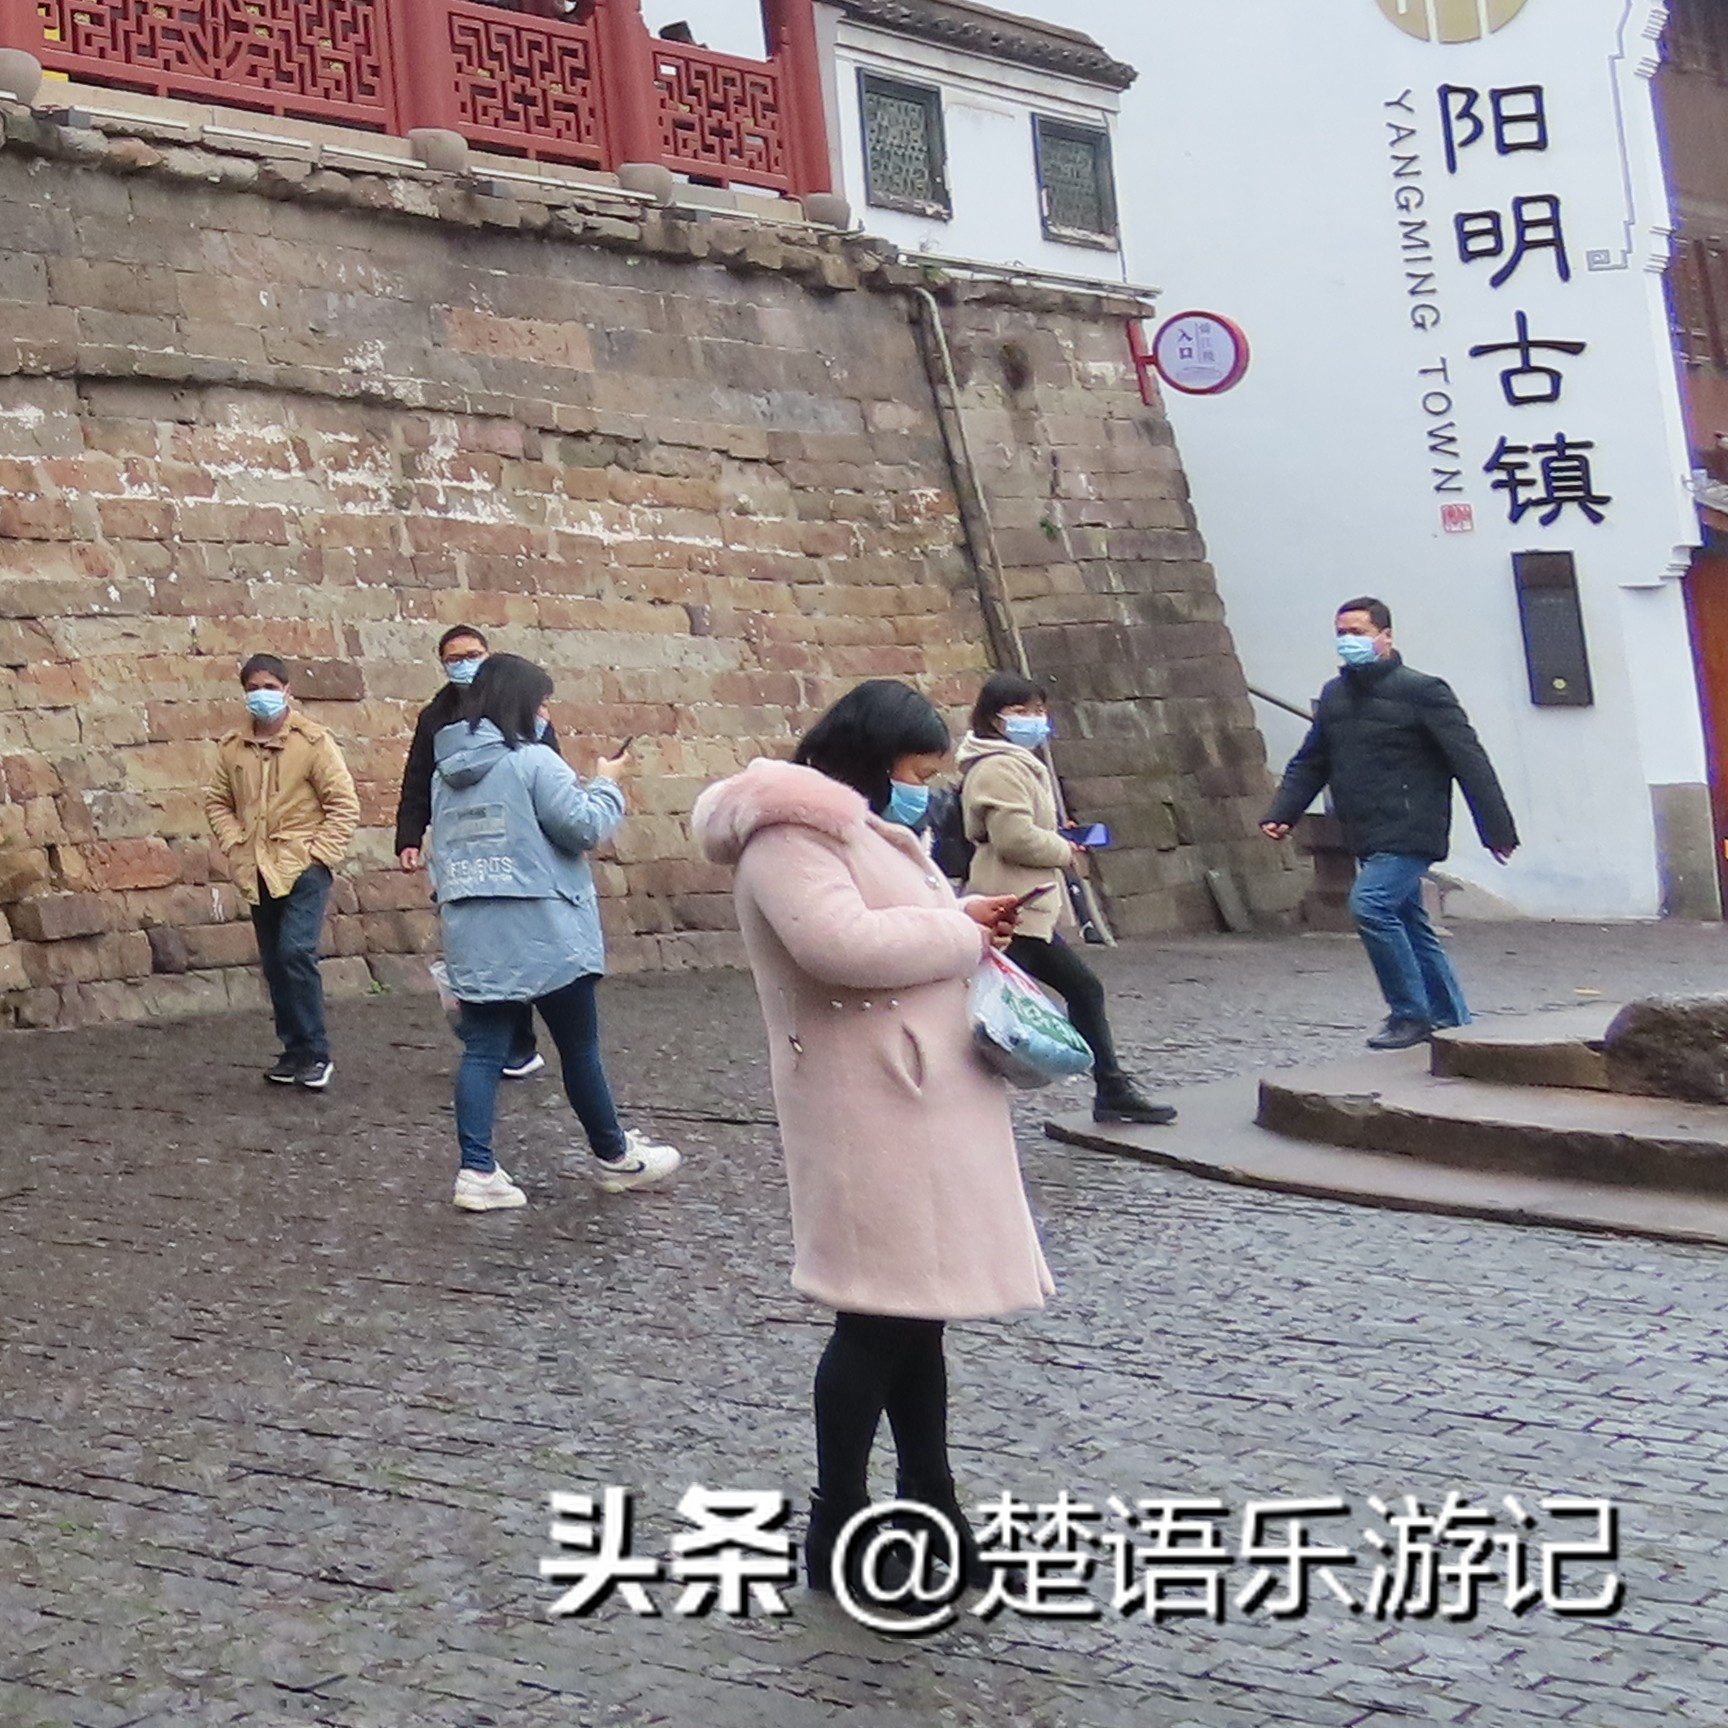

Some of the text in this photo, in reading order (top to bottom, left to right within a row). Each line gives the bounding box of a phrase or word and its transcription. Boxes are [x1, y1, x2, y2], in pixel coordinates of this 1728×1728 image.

[1176, 328, 1194, 361] 入口
[1383, 88, 1441, 333] YANGMING
[1418, 357, 1464, 494] TOWN
[1437, 83, 1612, 527] 阳明古镇
